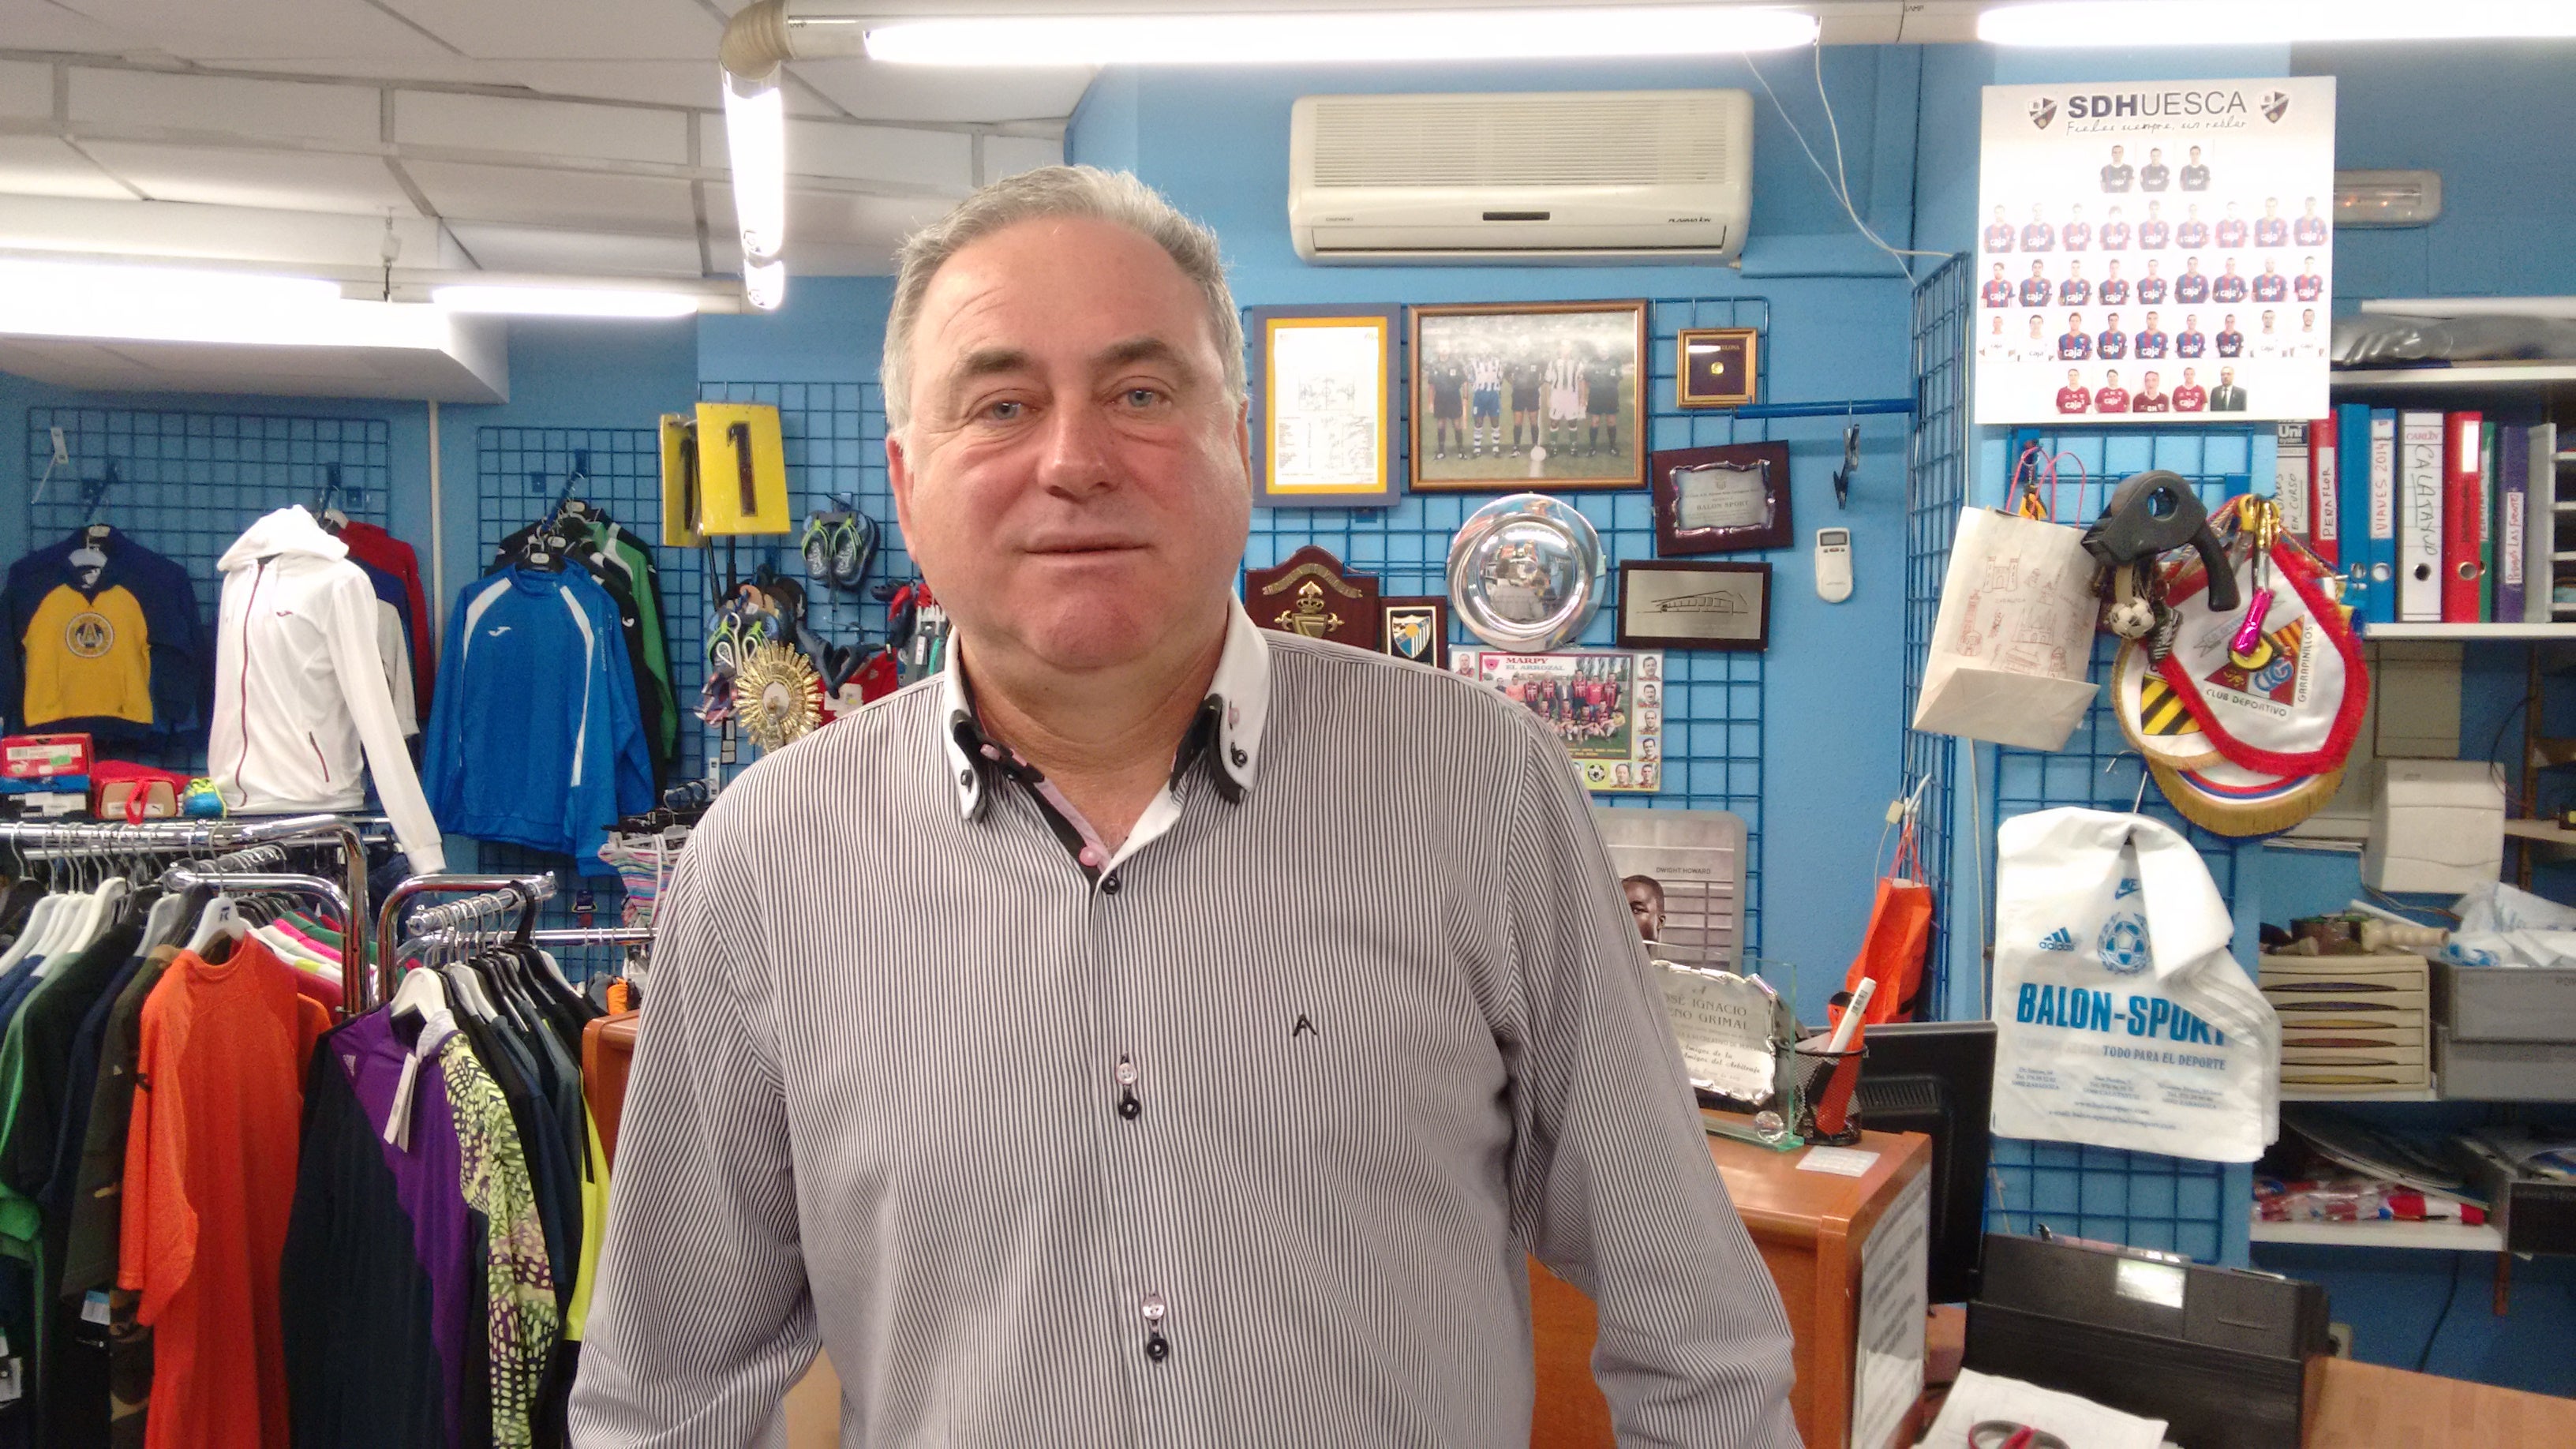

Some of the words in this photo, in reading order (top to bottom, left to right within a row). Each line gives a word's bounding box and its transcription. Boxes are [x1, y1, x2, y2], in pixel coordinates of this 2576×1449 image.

[2278, 426, 2303, 437] Uni
[2206, 688, 2230, 702] CLUB
[2232, 695, 2287, 717] DEPORTIVO
[1692, 998, 1747, 1017] IGNACIO
[1698, 1012, 1750, 1030] GRIMAL
[2102, 1045, 2131, 1059] TODO
[2133, 1048, 2159, 1063] PARA
[2162, 1052, 2176, 1065] EL
[2178, 1054, 2226, 1071] DEPORTE
